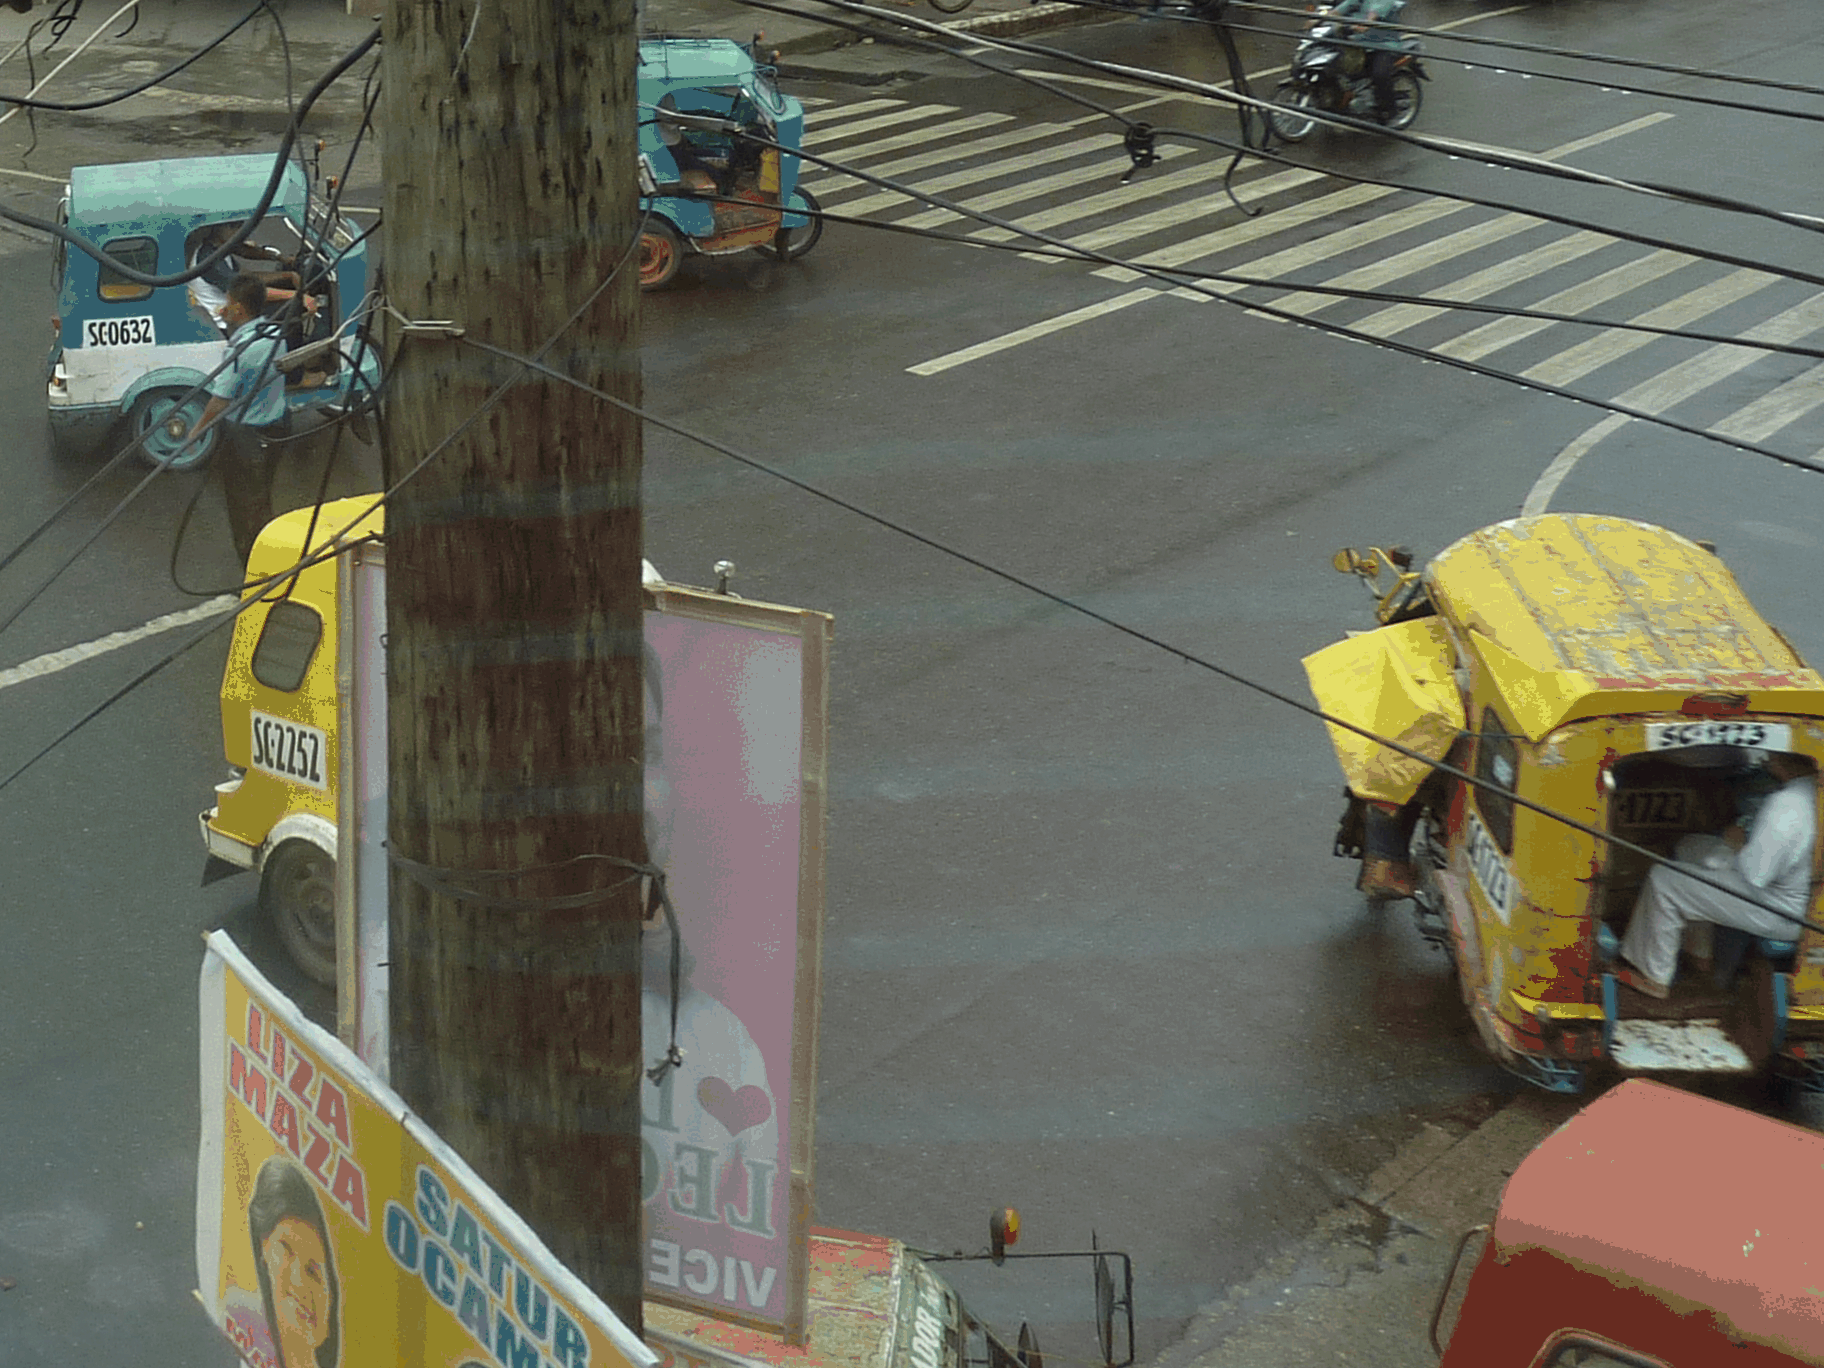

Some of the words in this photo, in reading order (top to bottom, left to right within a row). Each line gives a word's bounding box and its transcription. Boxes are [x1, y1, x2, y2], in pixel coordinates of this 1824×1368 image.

[229, 1041, 368, 1231] MAZA
[248, 1001, 352, 1152] LIZA
[384, 1201, 544, 1368] OCAM
[415, 1164, 589, 1368] SATUR
